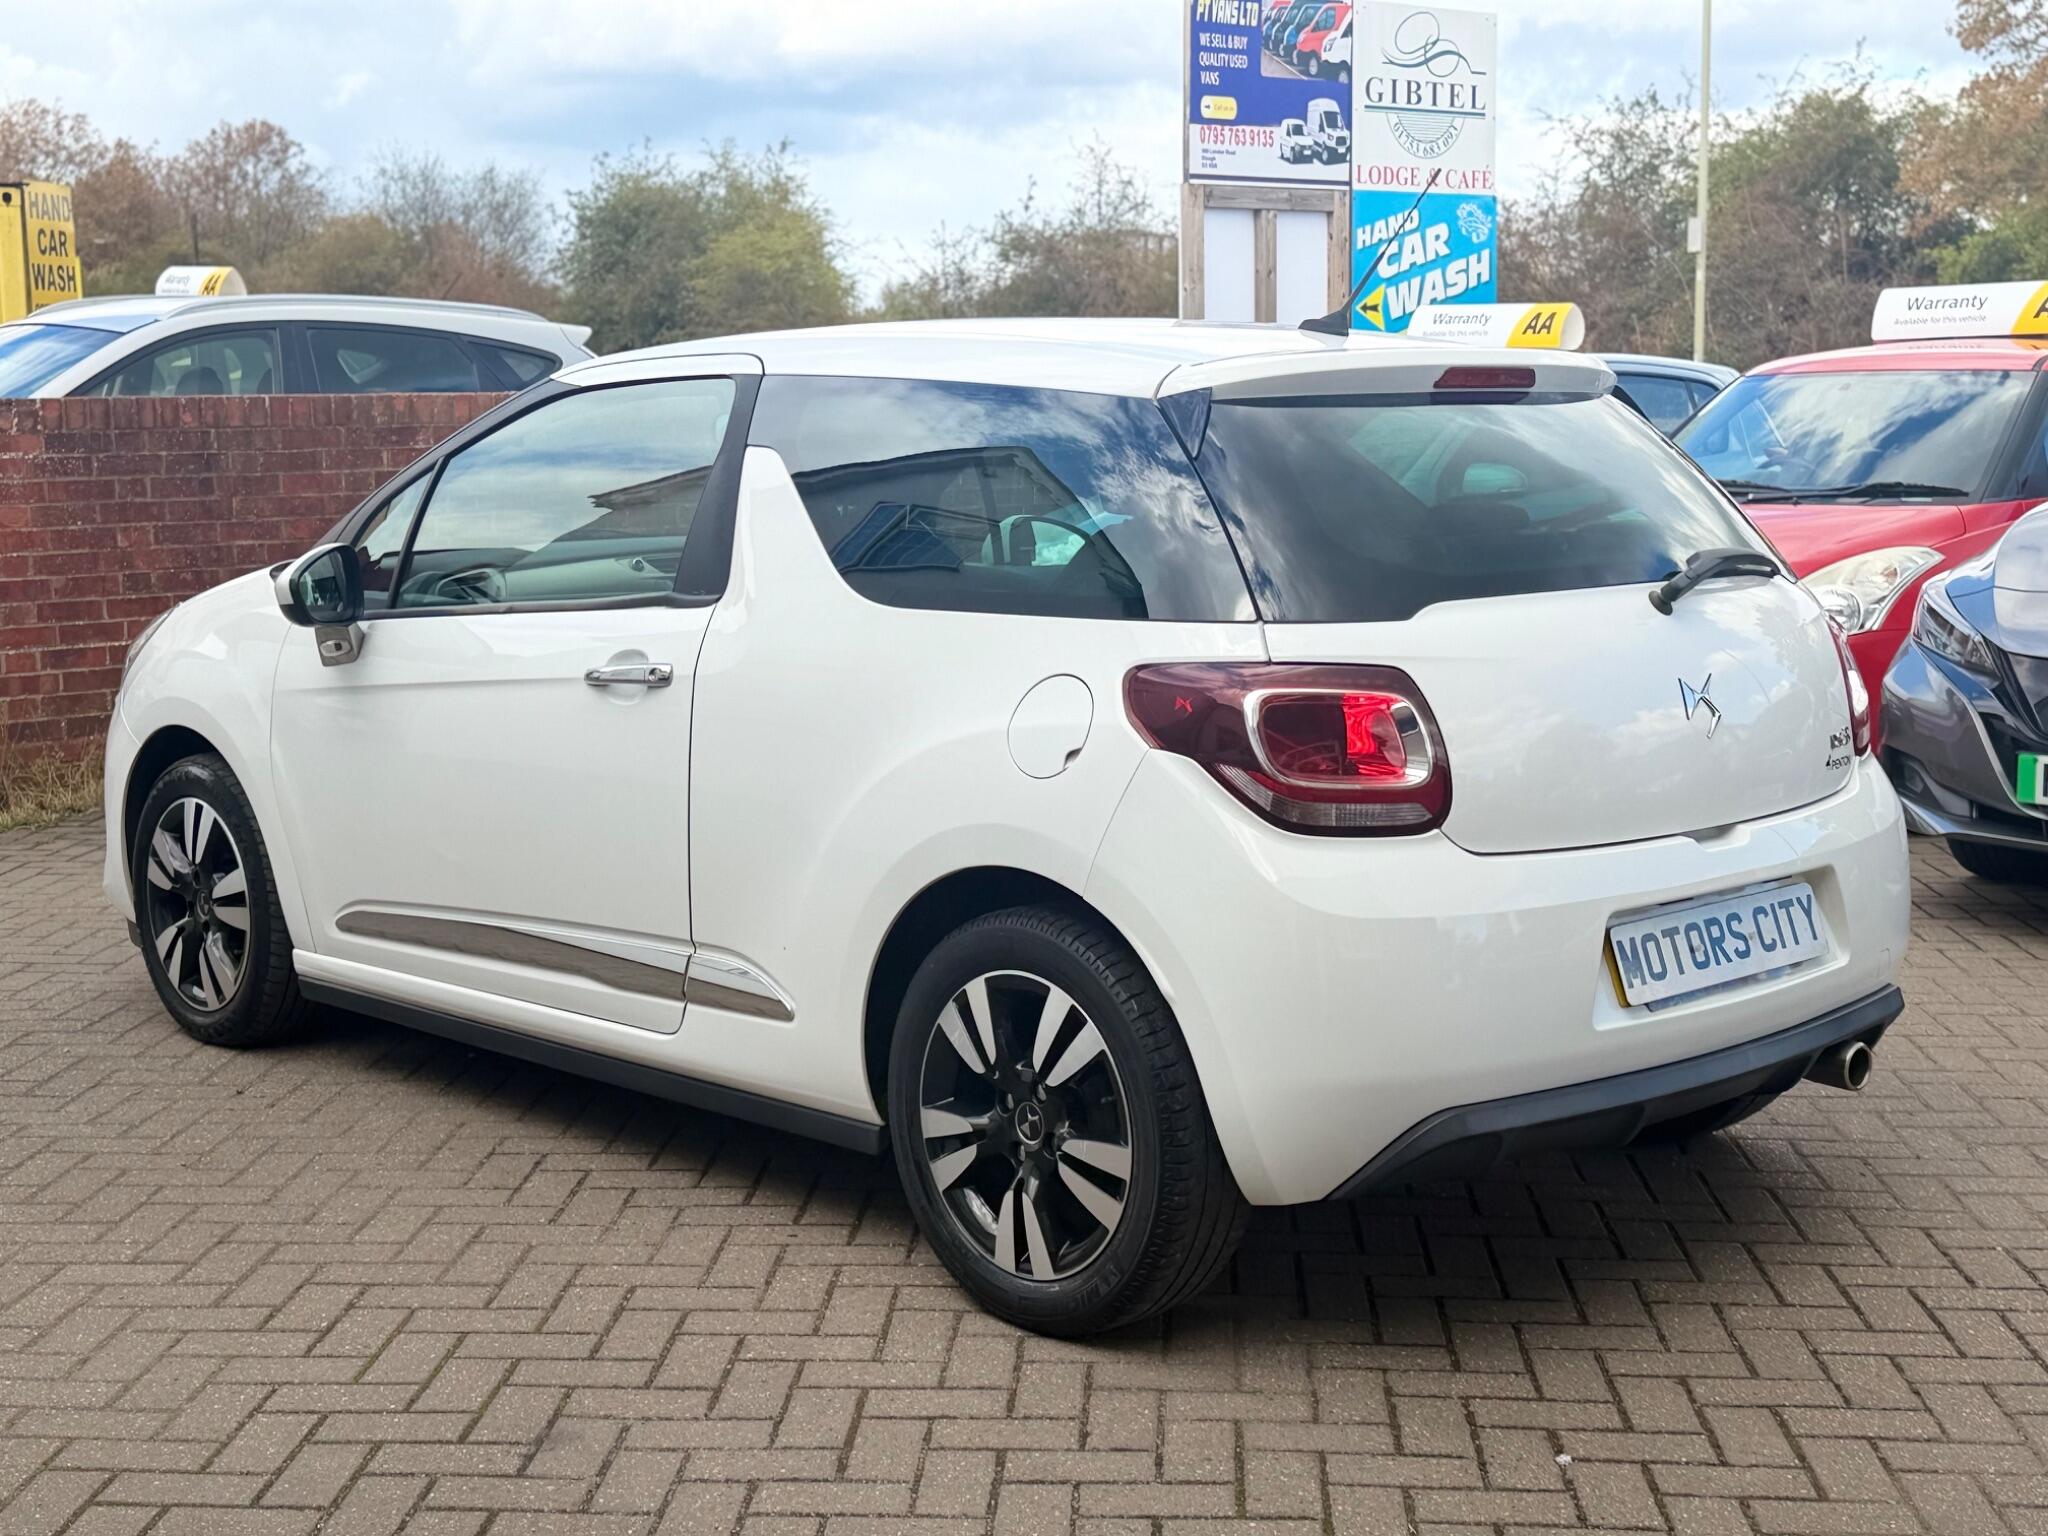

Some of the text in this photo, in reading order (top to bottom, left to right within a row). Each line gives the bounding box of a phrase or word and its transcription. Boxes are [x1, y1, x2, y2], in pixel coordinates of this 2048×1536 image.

[1212, 0, 1239, 25] VANS
[1239, 1, 1260, 27] LTD
[1199, 32, 1248, 50] WE SELL & BUY
[1199, 51, 1248, 69] QUALITY USED
[1199, 70, 1220, 85] VANS
[1365, 76, 1486, 110] GIBTEL
[1200, 125, 1275, 148] 0795 763 9135
[1356, 164, 1421, 187] LODGE
[1445, 164, 1493, 190] CAFÉ
[28, 191, 72, 222] HAND
[37, 227, 69, 257] CAR
[1356, 208, 1421, 250] HAND
[1376, 222, 1451, 280] CAR
[31, 262, 77, 292] WASH
[1385, 248, 1491, 320] WASH
[1907, 295, 1989, 311] Warranty
[1433, 312, 1492, 326] Warranty
[1522, 312, 1557, 335] AA
[1616, 894, 1818, 989] MOTORS CITY
